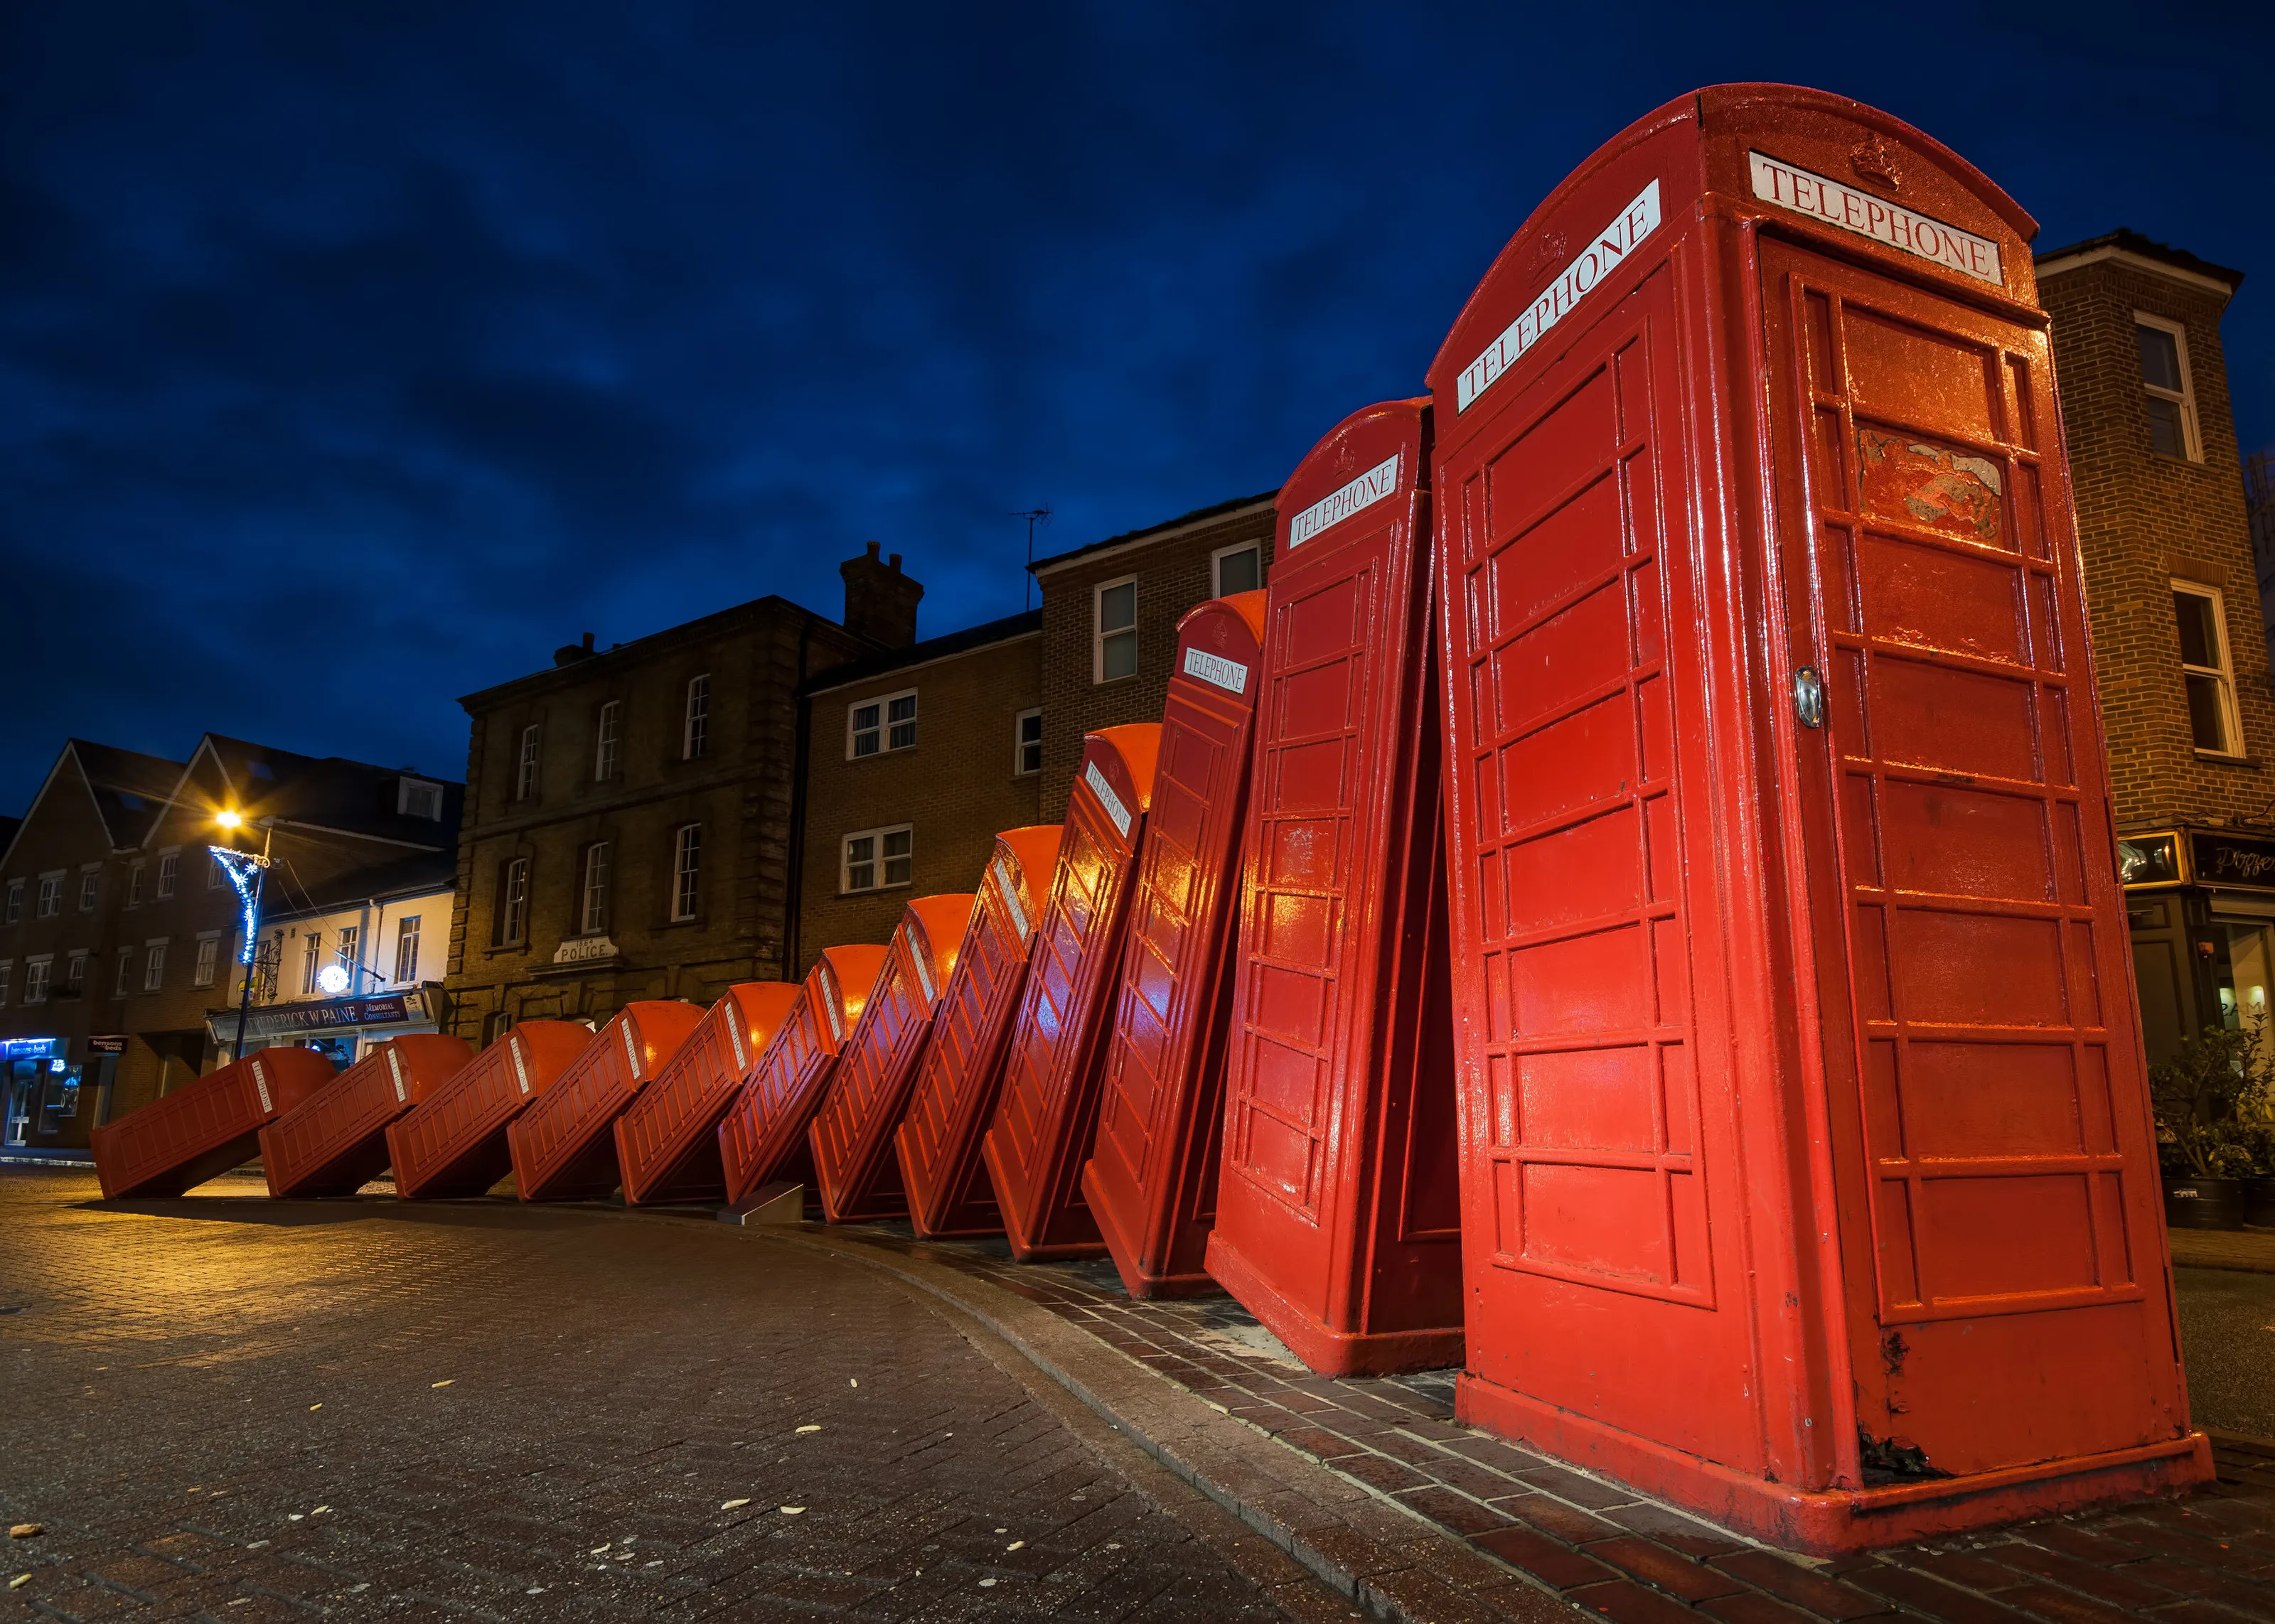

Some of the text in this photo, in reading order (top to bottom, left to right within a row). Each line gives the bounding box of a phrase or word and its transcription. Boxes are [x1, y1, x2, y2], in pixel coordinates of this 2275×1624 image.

[1762, 162, 1991, 276] TELEPHONE
[1465, 199, 1649, 399] TELEPHONE
[1295, 463, 1392, 541] TELEPHONE
[1189, 651, 1244, 690] TELEPHONE
[1089, 764, 1129, 832] TELEPHONE
[577, 938, 594, 947] 1864
[247, 1011, 309, 1031] FREDERICK
[307, 1010, 320, 1023] W
[321, 1006, 358, 1025] PAINE
[726, 1005, 744, 1066] TELEPHONE
[33, 1044, 47, 1054] beds
[512, 1040, 528, 1092] TELEPHONE
[623, 1021, 640, 1076] TELEPHONE
[254, 1062, 272, 1112] TELEPHONE
[389, 1050, 405, 1101] TELEPHONE
